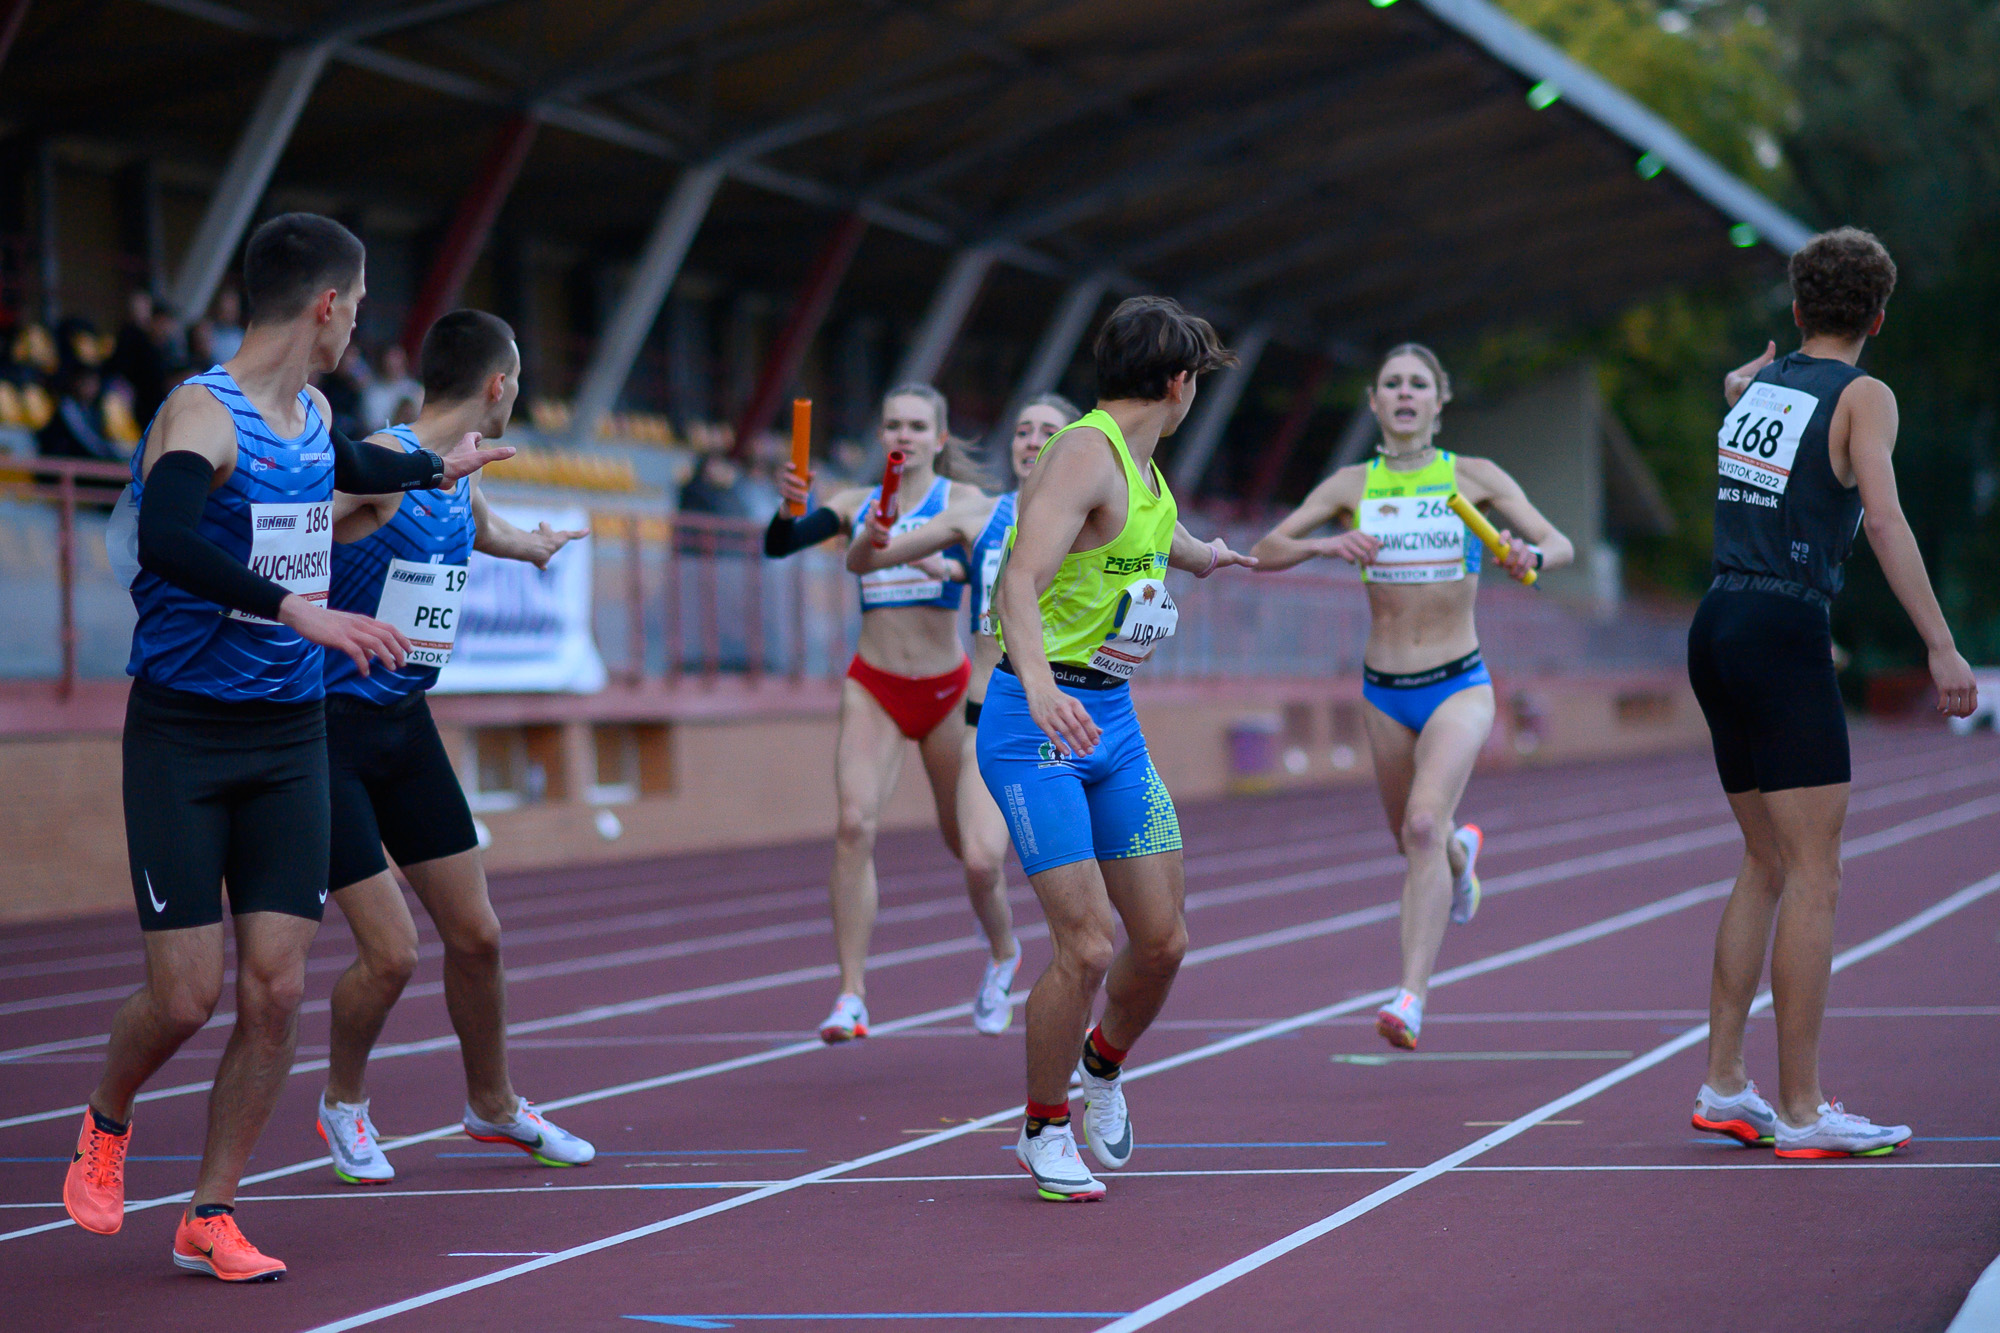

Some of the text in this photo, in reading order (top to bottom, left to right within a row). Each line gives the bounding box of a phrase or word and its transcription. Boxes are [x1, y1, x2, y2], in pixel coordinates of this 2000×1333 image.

[1727, 412, 1784, 458] 168
[1753, 471, 1780, 489] 2022
[305, 505, 330, 534] 186
[251, 551, 328, 581] KUCHARSKI
[445, 570, 469, 592] 19
[414, 606, 453, 630] PEC
[1093, 656, 1138, 676] BIAŁYSTO
